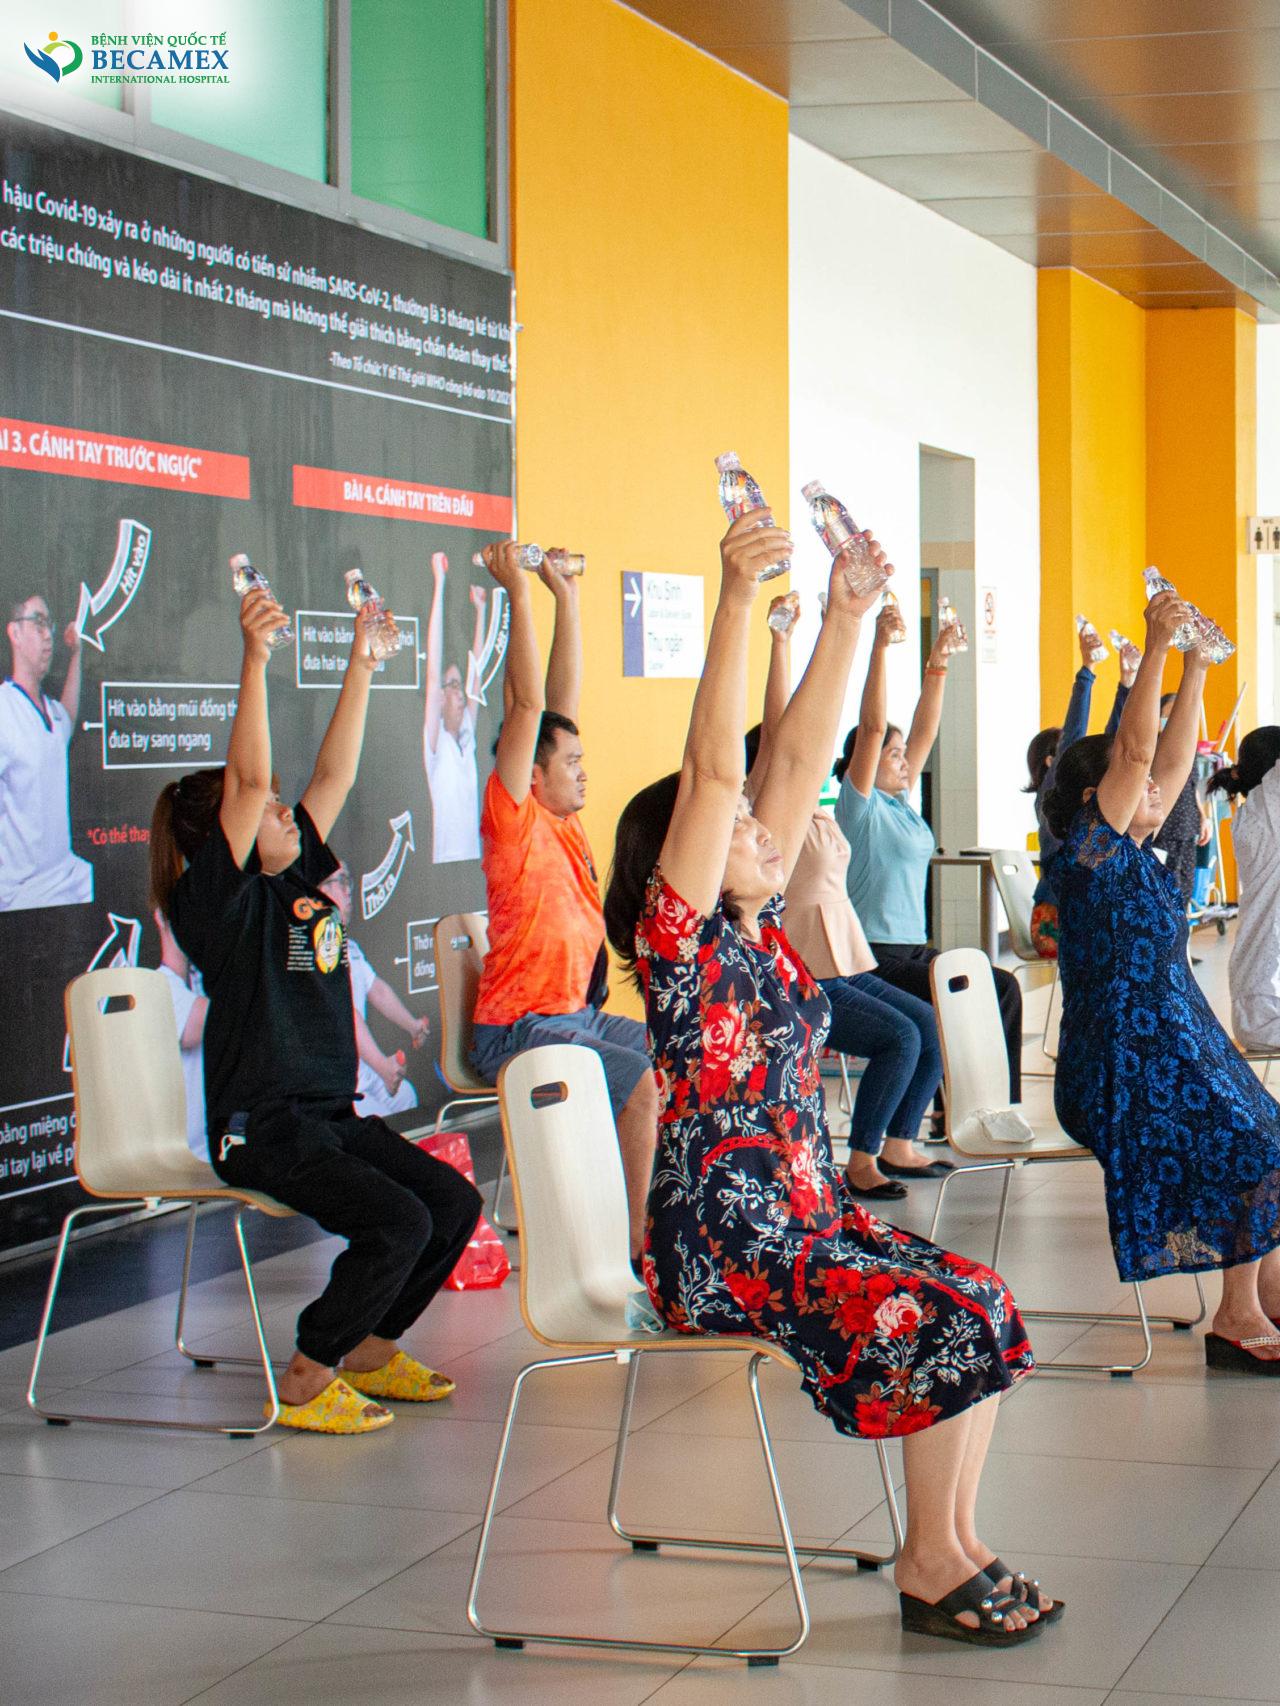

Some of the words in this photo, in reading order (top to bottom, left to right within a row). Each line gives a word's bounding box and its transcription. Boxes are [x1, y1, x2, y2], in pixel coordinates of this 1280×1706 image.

[2, 180, 33, 213] hậu
[36, 191, 97, 227] Covid-19
[98, 209, 122, 240] xảy
[125, 221, 138, 240] ra
[140, 220, 151, 242] ở
[152, 225, 196, 260] những
[197, 243, 235, 267] người
[235, 250, 250, 272] có
[328, 275, 392, 312] SARS-CoV-2,
[440, 307, 446, 325] 3
[0, 226, 26, 251] các
[28, 233, 65, 263] triệu
[67, 242, 112, 278] chứng
[114, 255, 131, 278] và
[133, 258, 158, 285] kéo
[160, 266, 181, 291] dài
[182, 272, 193, 295] ít
[194, 276, 225, 303] nhất
[225, 284, 234, 305] 2
[235, 287, 271, 319] tháng
[272, 299, 291, 320] mà
[292, 301, 328, 333] không
[12, 431, 27, 454] 3.
[29, 430, 74, 460] CÁNH
[75, 439, 103, 465] TAY
[105, 444, 156, 473] TRƯỚC
[343, 479, 363, 502] BÀI
[364, 485, 375, 504] 4.
[376, 483, 406, 508] CÁNH
[406, 490, 425, 511] TAY
[426, 492, 450, 514] TRÊN
[337, 656, 349, 672] ta
[107, 699, 125, 718] Hít
[126, 699, 148, 718] vào
[148, 698, 177, 722] bằng
[178, 700, 199, 717] mũi
[108, 730, 131, 749] đưa
[132, 732, 150, 752] tay
[151, 733, 177, 752] sang
[177, 733, 212, 751] ngang
[29, 1114, 68, 1138] miệng
[10, 1158, 30, 1178] tay
[31, 1149, 47, 1173] lại
